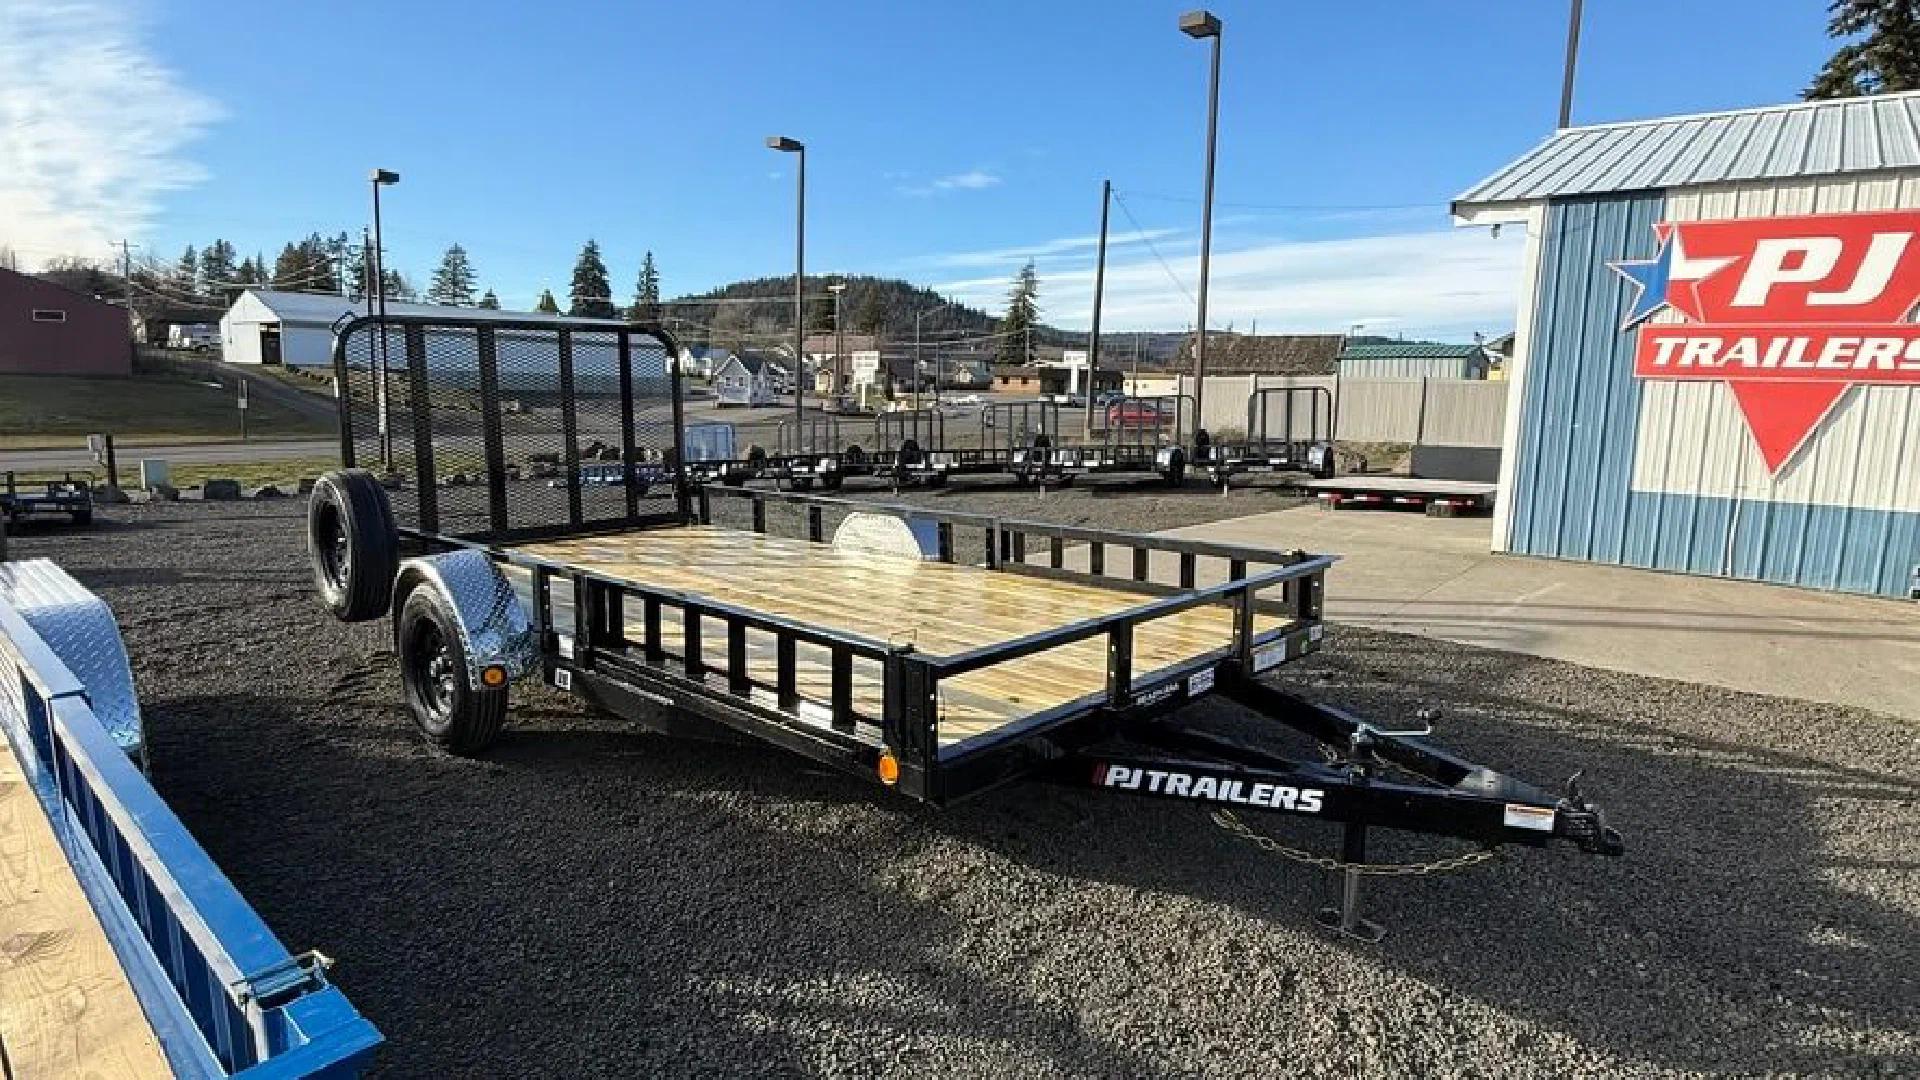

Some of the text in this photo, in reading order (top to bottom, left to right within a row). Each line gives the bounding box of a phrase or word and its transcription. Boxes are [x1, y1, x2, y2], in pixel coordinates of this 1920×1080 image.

[1731, 231, 1914, 306] PJ
[1105, 765, 1324, 812] PJ TRAILERS
